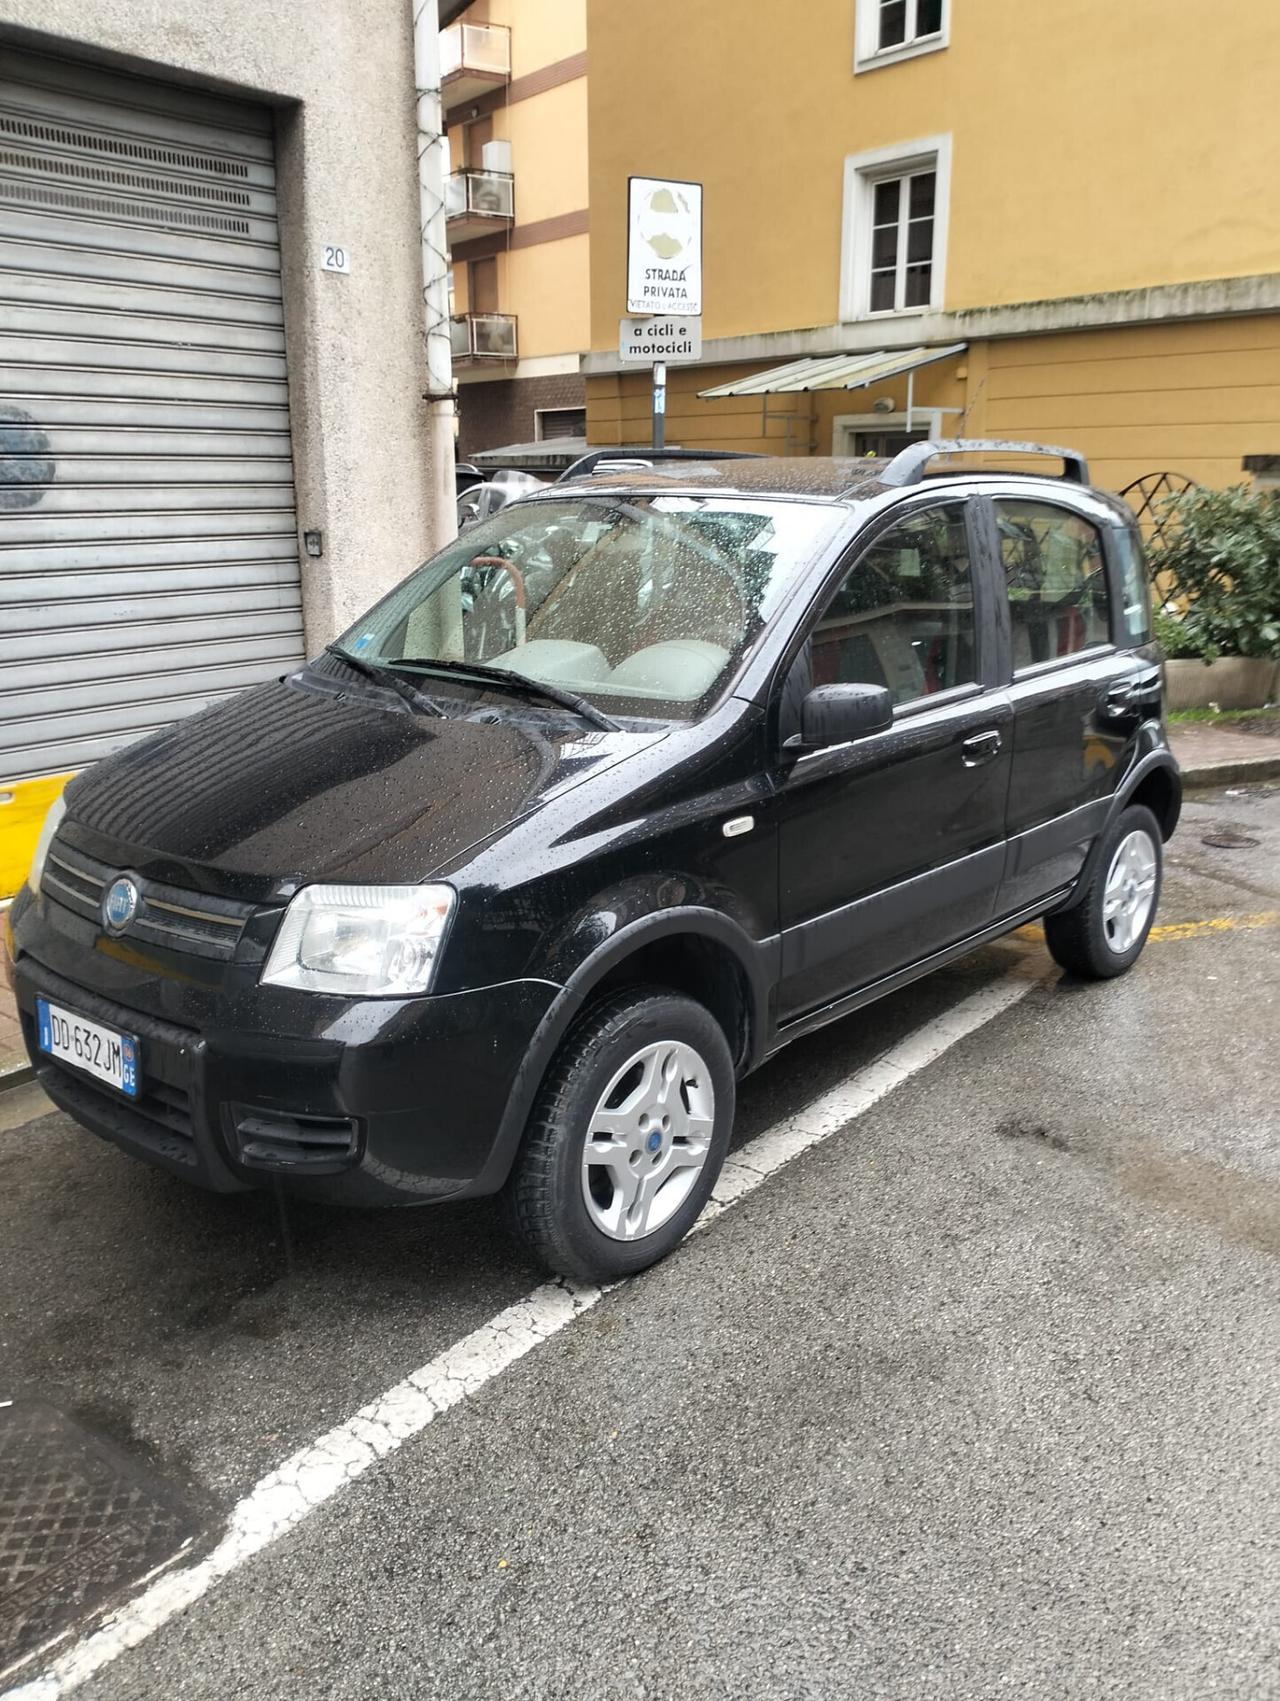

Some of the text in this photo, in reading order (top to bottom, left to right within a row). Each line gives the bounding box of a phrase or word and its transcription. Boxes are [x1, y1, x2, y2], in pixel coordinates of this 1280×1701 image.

[326, 247, 344, 268] 20
[645, 268, 686, 281] STRADA
[643, 286, 687, 298] PRIVATA
[634, 324, 687, 336] a cicli e
[629, 341, 691, 354] motocicli
[123, 1063, 136, 1087] GE
